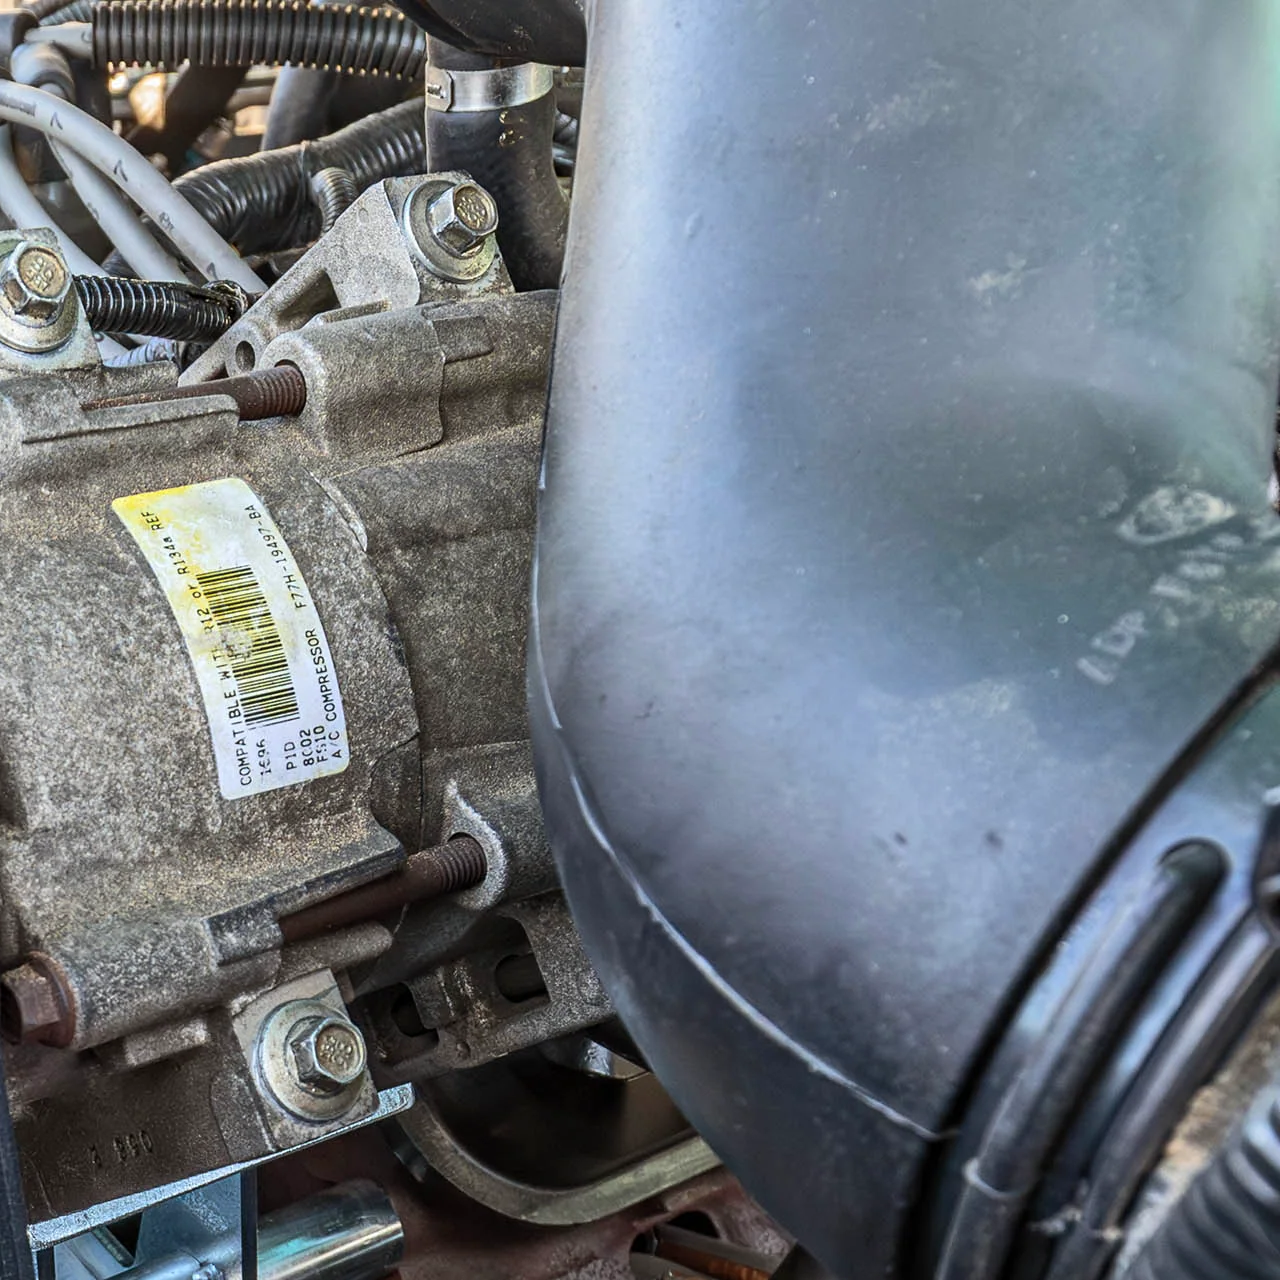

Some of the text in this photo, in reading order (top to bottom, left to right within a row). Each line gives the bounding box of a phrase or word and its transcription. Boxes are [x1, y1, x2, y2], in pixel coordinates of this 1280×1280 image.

[141, 511, 164, 531] REF
[304, 628, 338, 722] COMPRESSOR
[228, 690, 253, 787] COMPATIBLE
[323, 730, 342, 759] A/C
